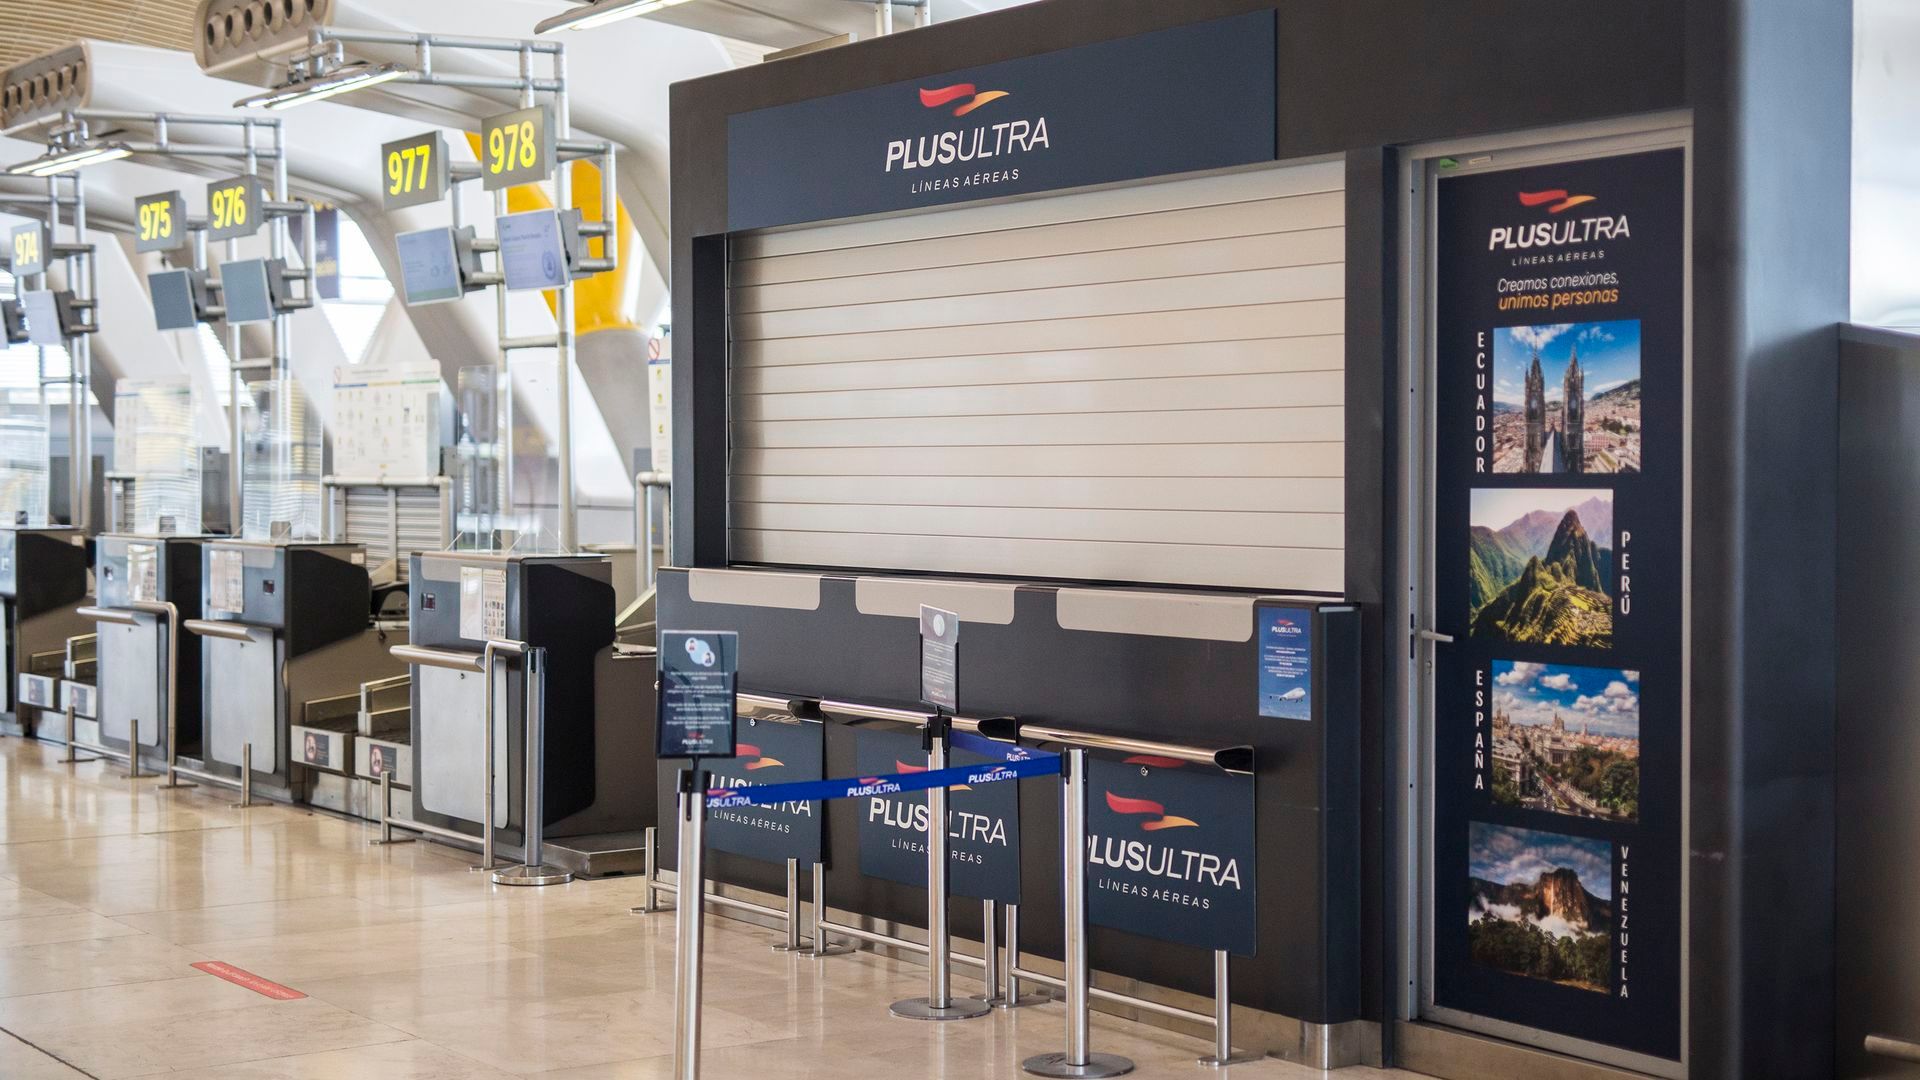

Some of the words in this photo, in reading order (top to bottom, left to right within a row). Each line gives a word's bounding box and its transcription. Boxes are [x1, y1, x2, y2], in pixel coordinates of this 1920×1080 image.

[489, 120, 536, 174] 978
[885, 117, 1049, 172] PLUSULTRA
[388, 145, 430, 195] 977
[911, 177, 960, 194] LÍNEAS
[963, 168, 1020, 187] AÉREAS
[139, 201, 172, 241] 975
[212, 186, 247, 229] 976
[15, 231, 38, 266] 974
[1489, 214, 1630, 251] PLUSULTRA
[1512, 255, 1553, 266] LÍNEAS
[1557, 250, 1605, 262] AÉREAS
[1497, 278, 1548, 293] Creamos
[1550, 271, 1619, 289] conexiones,
[1499, 292, 1549, 311] unimos
[1551, 288, 1619, 310] personas
[1476, 331, 1485, 474] ECUADOR
[1620, 531, 1631, 615] PERÚ
[1474, 669, 1484, 790] ESPAÑA
[847, 783, 901, 797] PLUSULTRA
[968, 770, 1018, 784] PLUSULTRA
[714, 810, 748, 825] LÍNEAS
[750, 818, 790, 834] AÉREAS
[869, 797, 1007, 846] PLUSLTRA
[952, 850, 983, 865] REAS
[1087, 834, 1241, 890] LUSULTRA
[1099, 878, 1148, 897] LÍNEAS
[1152, 889, 1210, 909] AÉREAS
[1620, 846, 1629, 999] VENEZUELA
